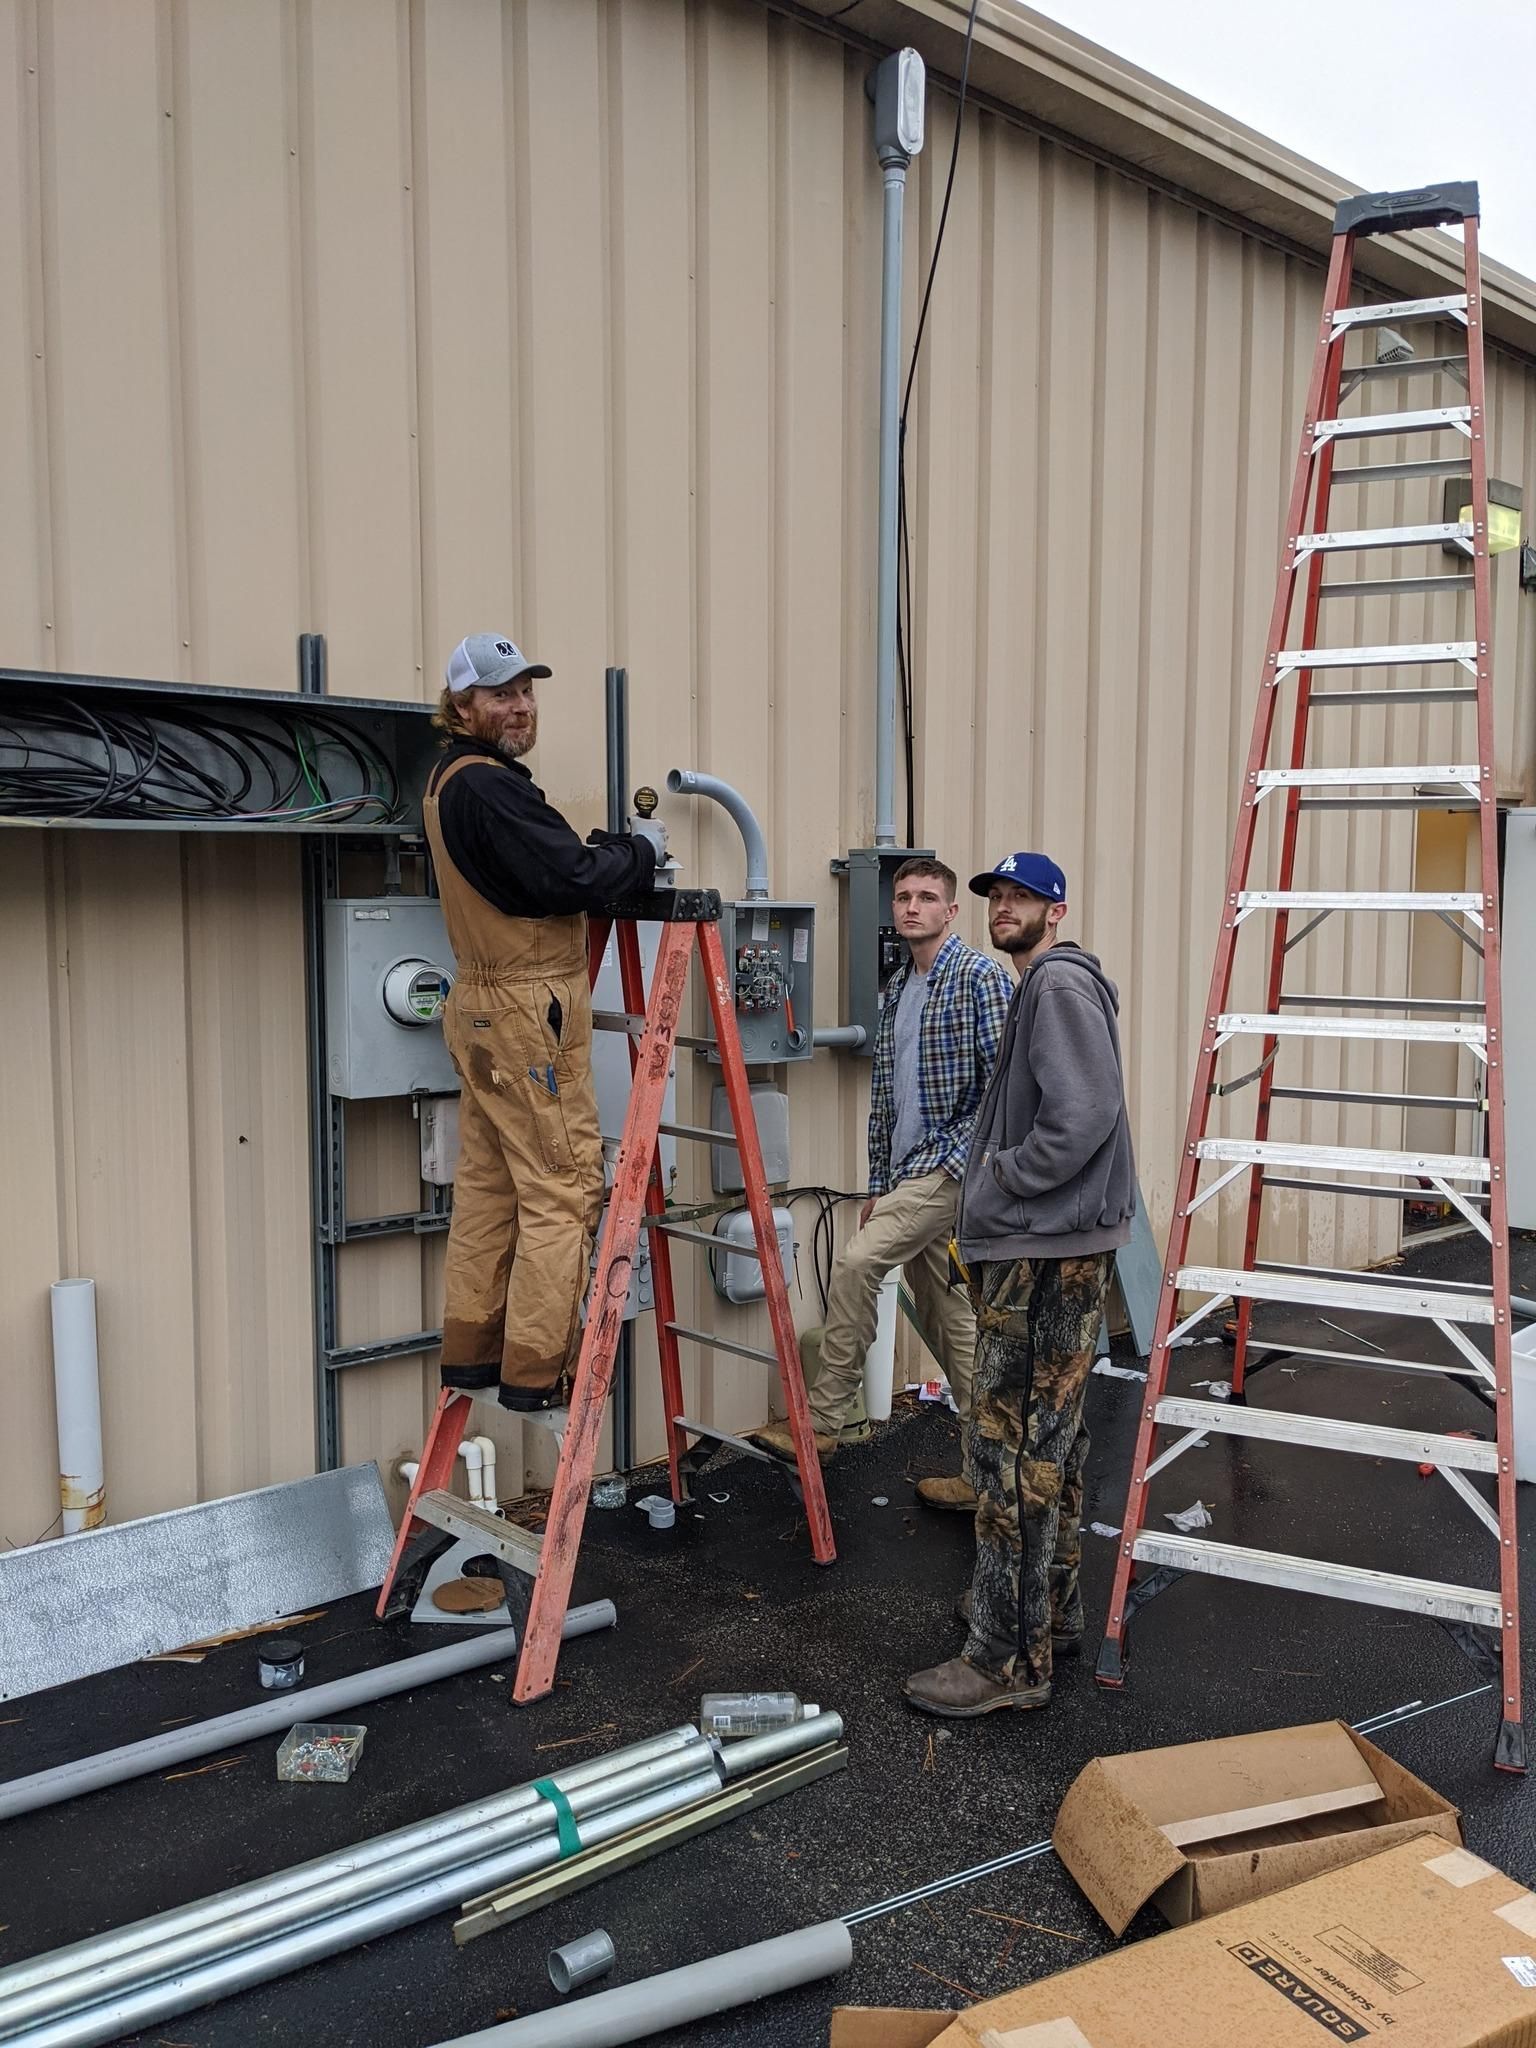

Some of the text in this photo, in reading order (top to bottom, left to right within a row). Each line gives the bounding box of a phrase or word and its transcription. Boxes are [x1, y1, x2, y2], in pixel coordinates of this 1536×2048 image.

[1000, 855, 1017, 871] LA
[1267, 1931, 1313, 1964] Electric
[1258, 1962, 1358, 2037] SQUARE
[1313, 1966, 1376, 2011] Schneider
[1376, 2012, 1397, 2025] by
